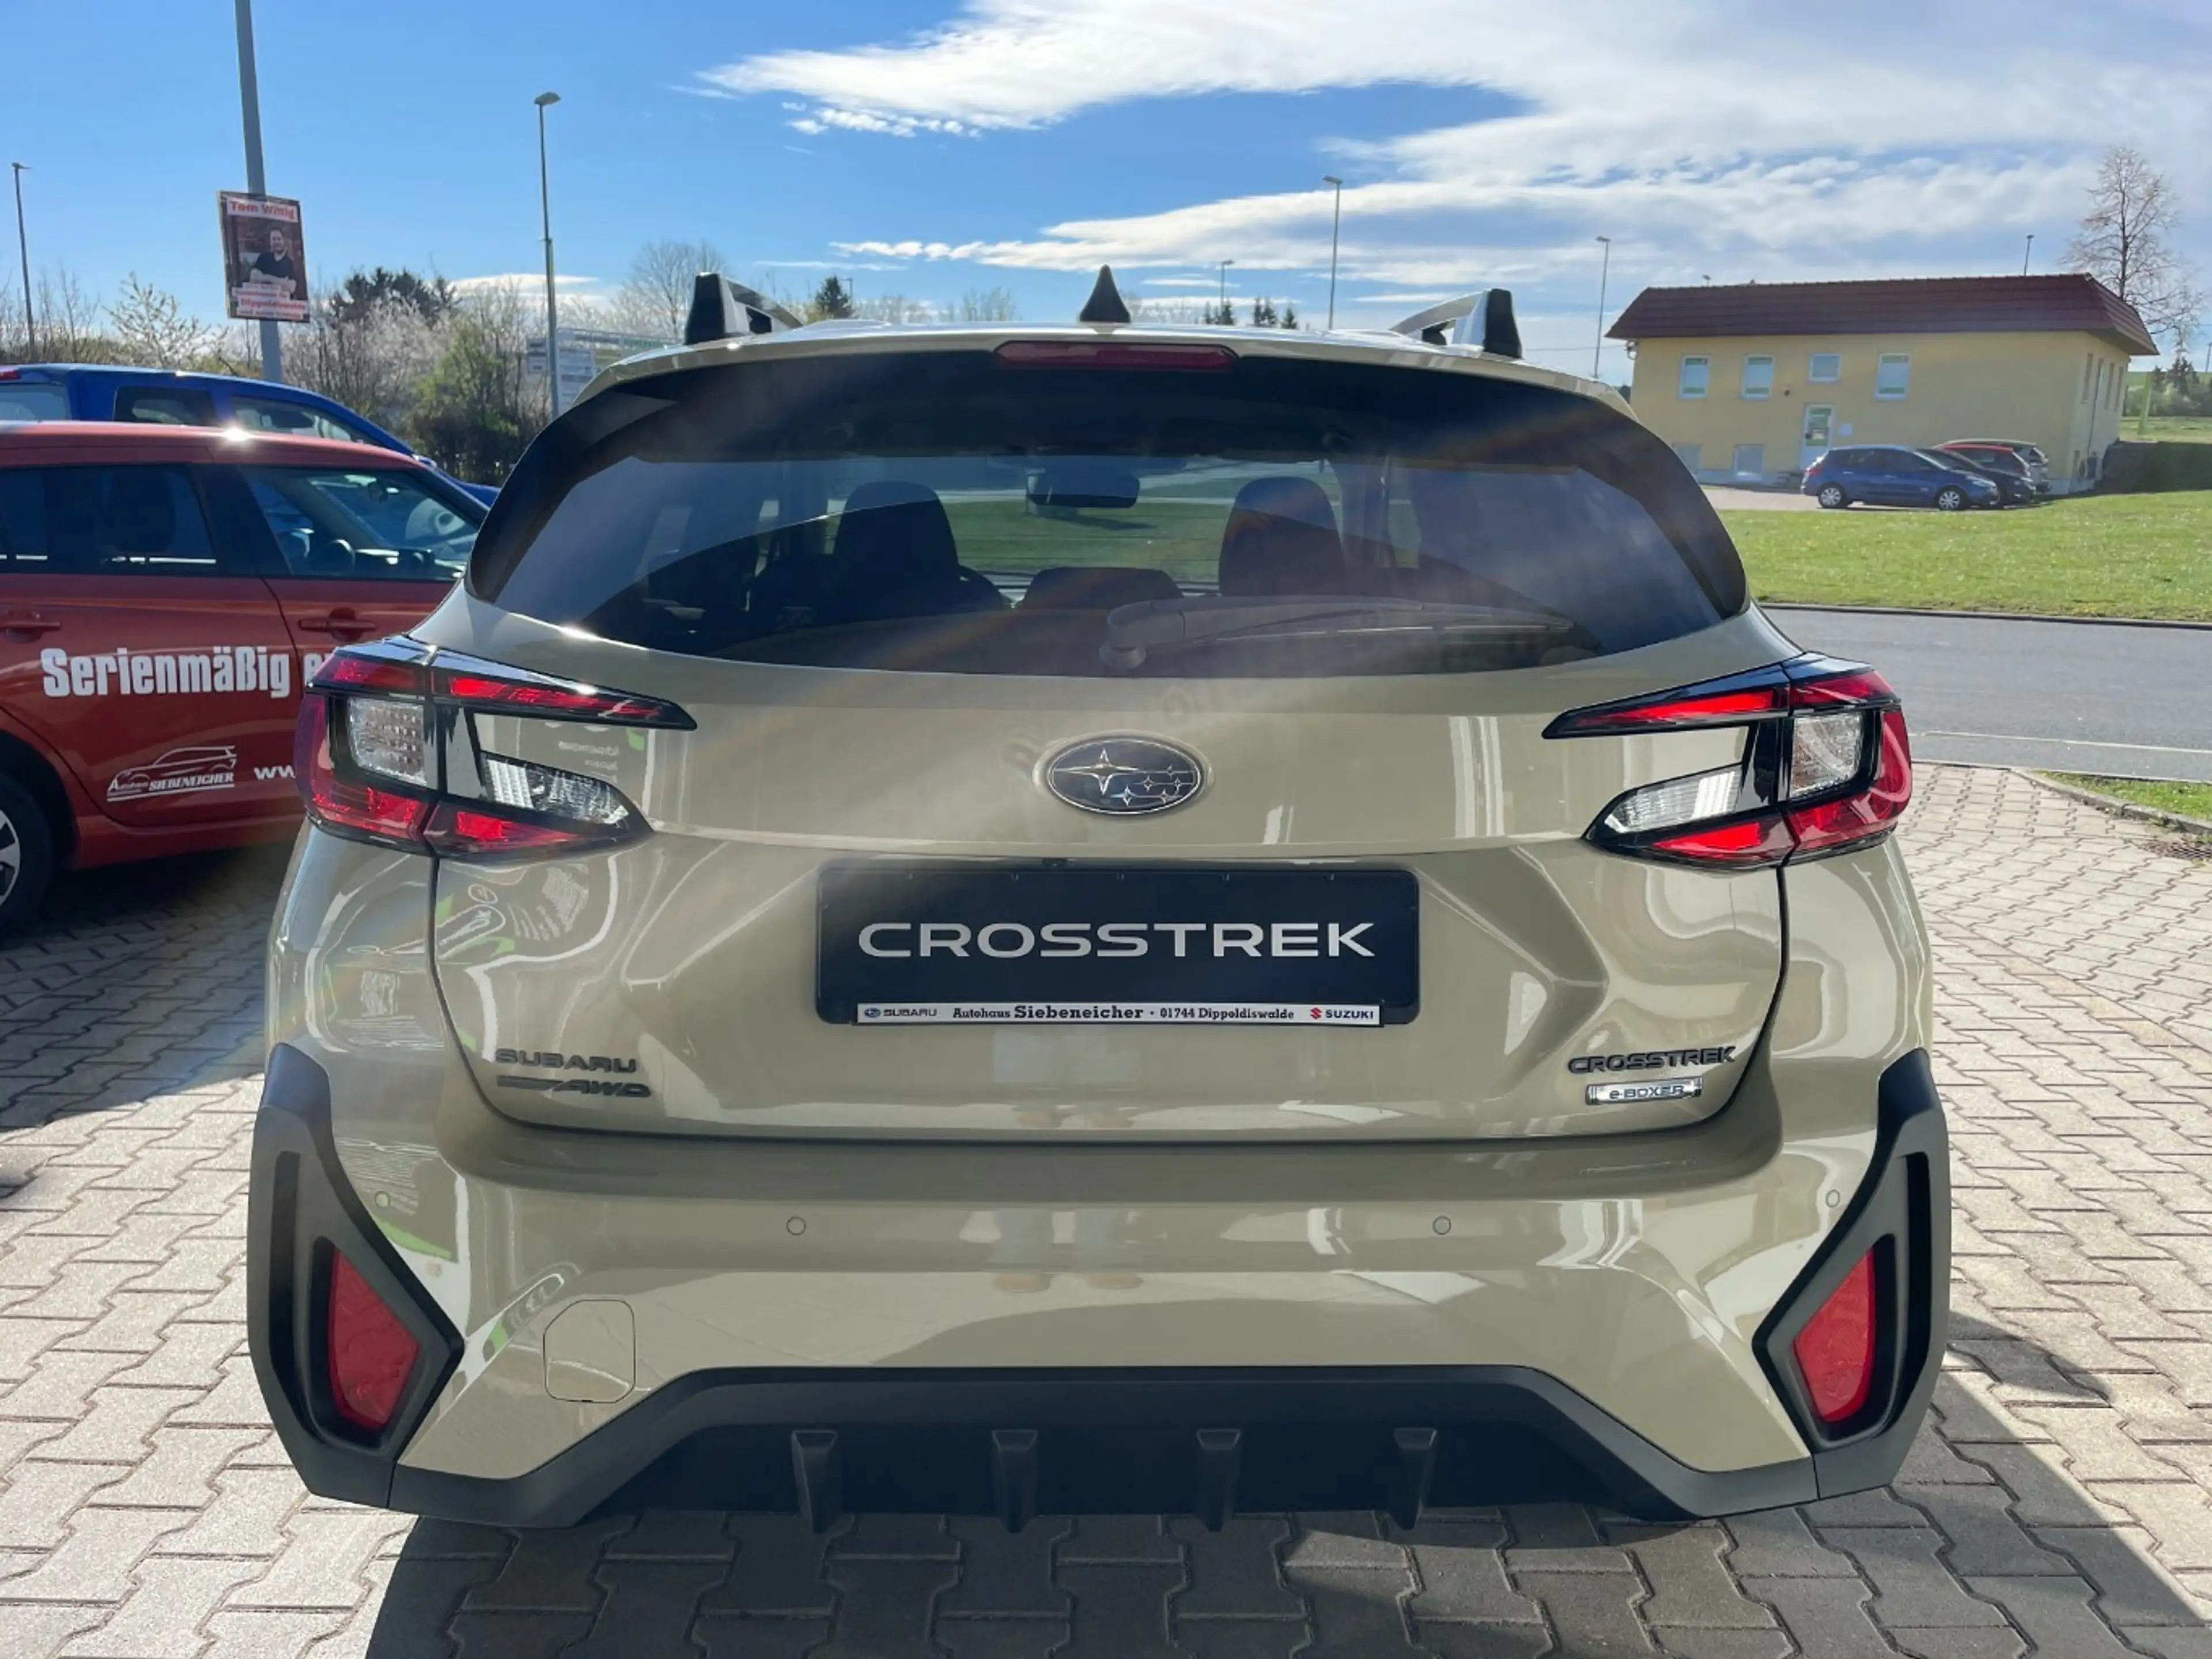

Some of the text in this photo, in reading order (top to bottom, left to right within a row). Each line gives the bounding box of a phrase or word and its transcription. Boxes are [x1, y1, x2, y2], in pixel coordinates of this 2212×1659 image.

[40, 646, 290, 698] Serienmäßig
[858, 922, 1375, 958] CROSSTREK
[883, 1005, 1374, 1021] SUBARU Autohaus Siebeneicher 01744 Dippoldiswalde SUZUKI
[495, 1048, 637, 1073] SUBARU
[1568, 1046, 1736, 1074] CROSSTREK
